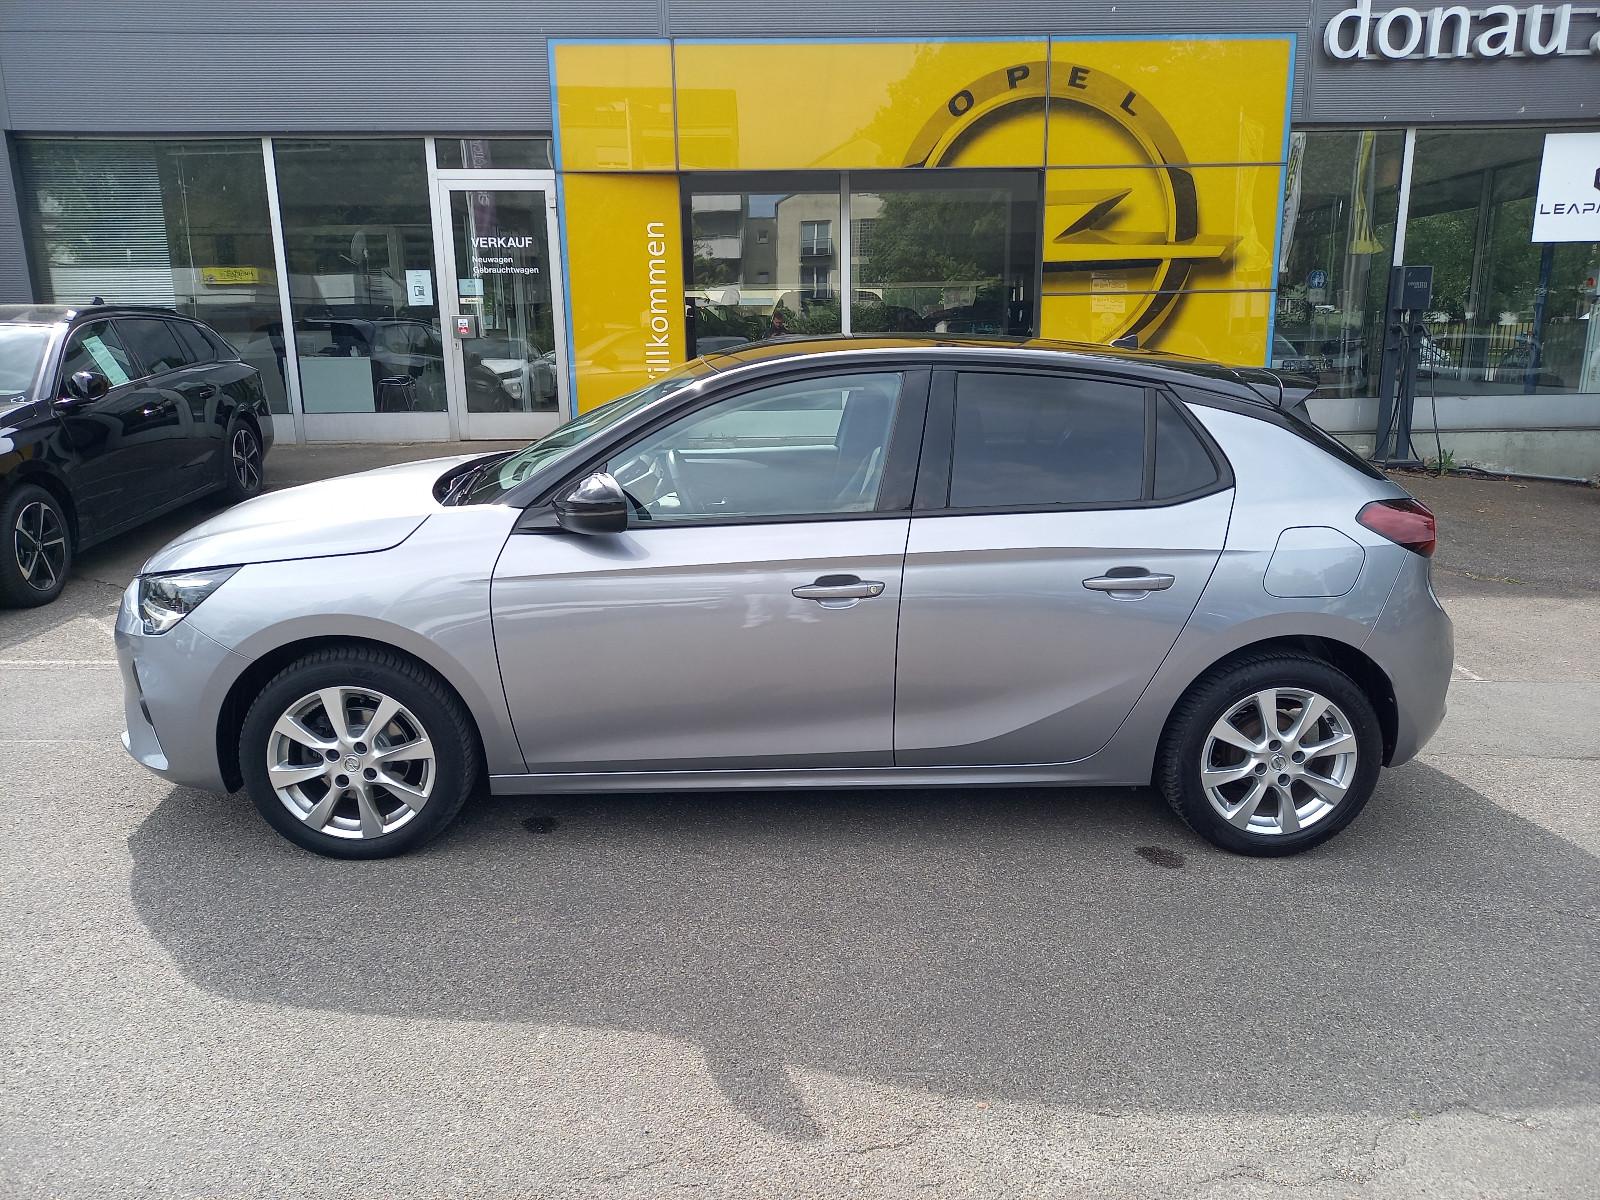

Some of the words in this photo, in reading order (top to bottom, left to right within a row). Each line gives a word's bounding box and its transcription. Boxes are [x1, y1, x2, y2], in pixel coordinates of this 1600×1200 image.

[1323, 0, 1572, 60] donau
[948, 64, 1137, 117] OPEL
[1539, 203, 1600, 214] LEAP
[471, 236, 533, 248] VERKAUF
[472, 256, 514, 264] Neuwagen
[472, 266, 540, 275] Gebrauchtwagen
[645, 221, 671, 380] illkommen
